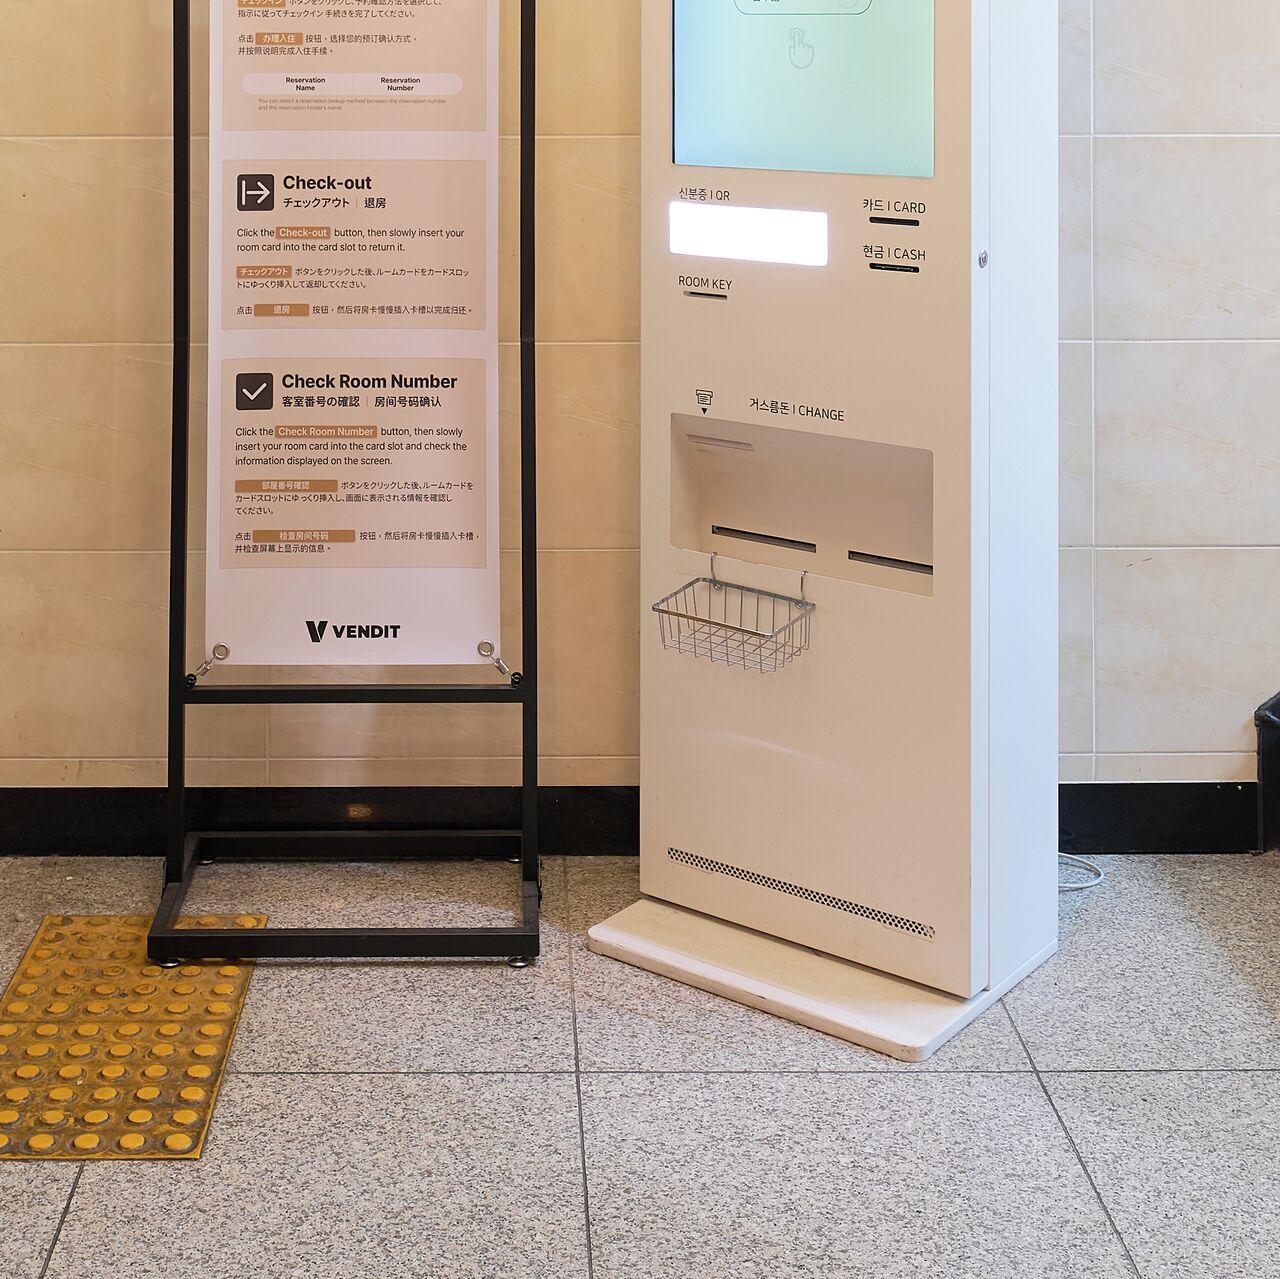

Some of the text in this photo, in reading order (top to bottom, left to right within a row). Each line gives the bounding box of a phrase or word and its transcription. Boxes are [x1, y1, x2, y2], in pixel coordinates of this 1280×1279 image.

[283, 175, 372, 189] Check-out
[678, 187, 730, 201] 신분증 QR
[283, 197, 386, 209] チェックアウト 退房
[863, 198, 926, 214] 카드 CARD
[236, 227, 464, 239] Click the Check-out button, then slowly insert your
[236, 242, 405, 252] room card into the card slot to return it.
[862, 244, 926, 261] 현금 CASH
[678, 275, 732, 290] ROOM KEY
[281, 374, 458, 389] Check Room Number
[282, 395, 442, 408] 客室番号の確認 房间号码确认
[749, 398, 844, 421] 거스름돈 CHANGE
[235, 427, 463, 438] Click the Check Room Number button, then slowly
[235, 441, 467, 452] insert your room card into the card slot and check the
[235, 456, 285, 466] information
[286, 456, 328, 467] displayed
[344, 456, 358, 465] the
[360, 457, 392, 465] screen.
[331, 625, 401, 638] VENDIT
